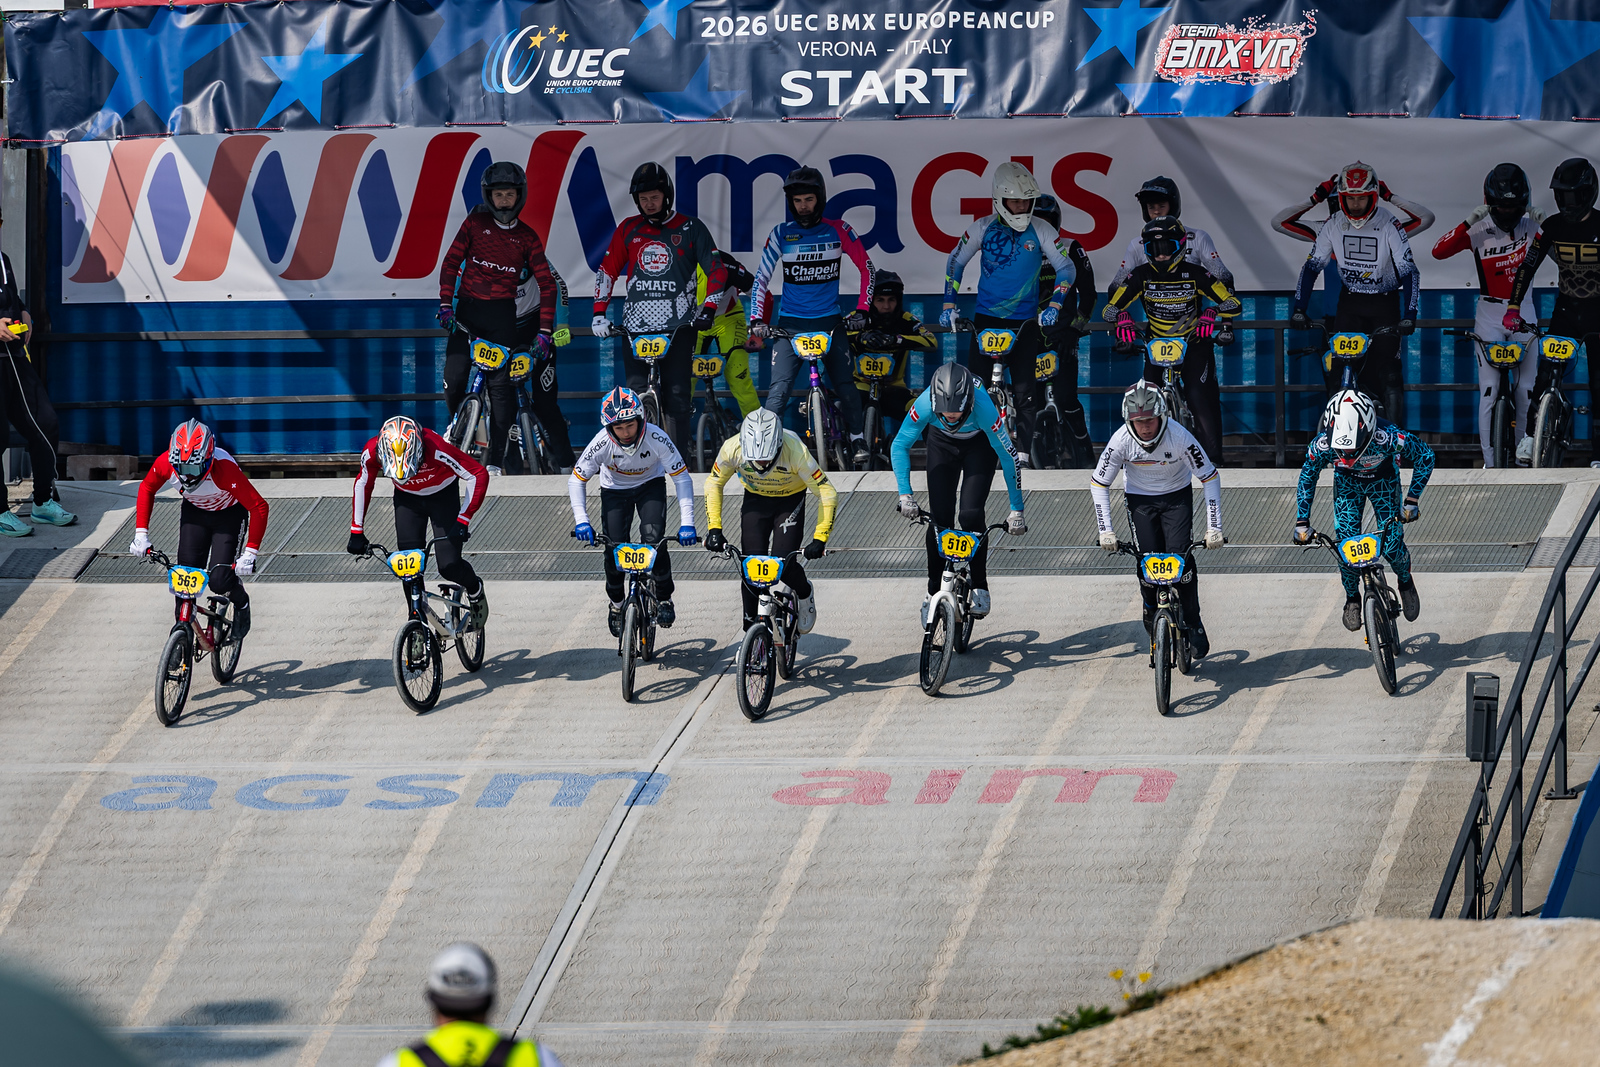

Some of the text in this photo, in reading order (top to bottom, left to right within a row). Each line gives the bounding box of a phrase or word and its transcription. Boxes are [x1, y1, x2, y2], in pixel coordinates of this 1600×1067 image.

[701, 11, 1055, 37] 2026 UEC BMX EUROPEANCUP
[1180, 26, 1219, 37] TEAM
[798, 41, 877, 56] VERONA
[905, 39, 953, 55] ITALY
[1165, 39, 1297, 68] BMX-VR
[549, 48, 630, 78] UEC
[781, 68, 967, 106] START
[1484, 232, 1528, 257] HUFFY
[472, 256, 517, 273] LATVIA
[643, 254, 667, 264] BMX
[1344, 261, 1378, 269] PROSTART
[1341, 268, 1362, 277] STAY
[635, 280, 676, 292] SMAFC
[641, 342, 660, 353] 615
[803, 339, 821, 350] 553
[988, 336, 1006, 347] 617
[1340, 340, 1358, 350] 643
[479, 347, 498, 362] 605
[1161, 345, 1173, 356] 02
[1496, 349, 1515, 359] 604
[1549, 343, 1568, 354] 025
[698, 362, 716, 372] 640
[1036, 358, 1051, 372] 580
[652, 432, 675, 454] Cofidis
[1187, 444, 1205, 468] KTM
[404, 474, 436, 485] STRIA
[1095, 503, 1106, 532] BIORACER
[1209, 499, 1218, 528] BIORACER
[948, 538, 967, 552] 518
[1350, 543, 1370, 557] 588
[398, 557, 415, 570] 612
[625, 552, 645, 564] 608
[757, 564, 768, 576] 16
[1153, 562, 1173, 574] 584
[177, 574, 197, 588] 563
